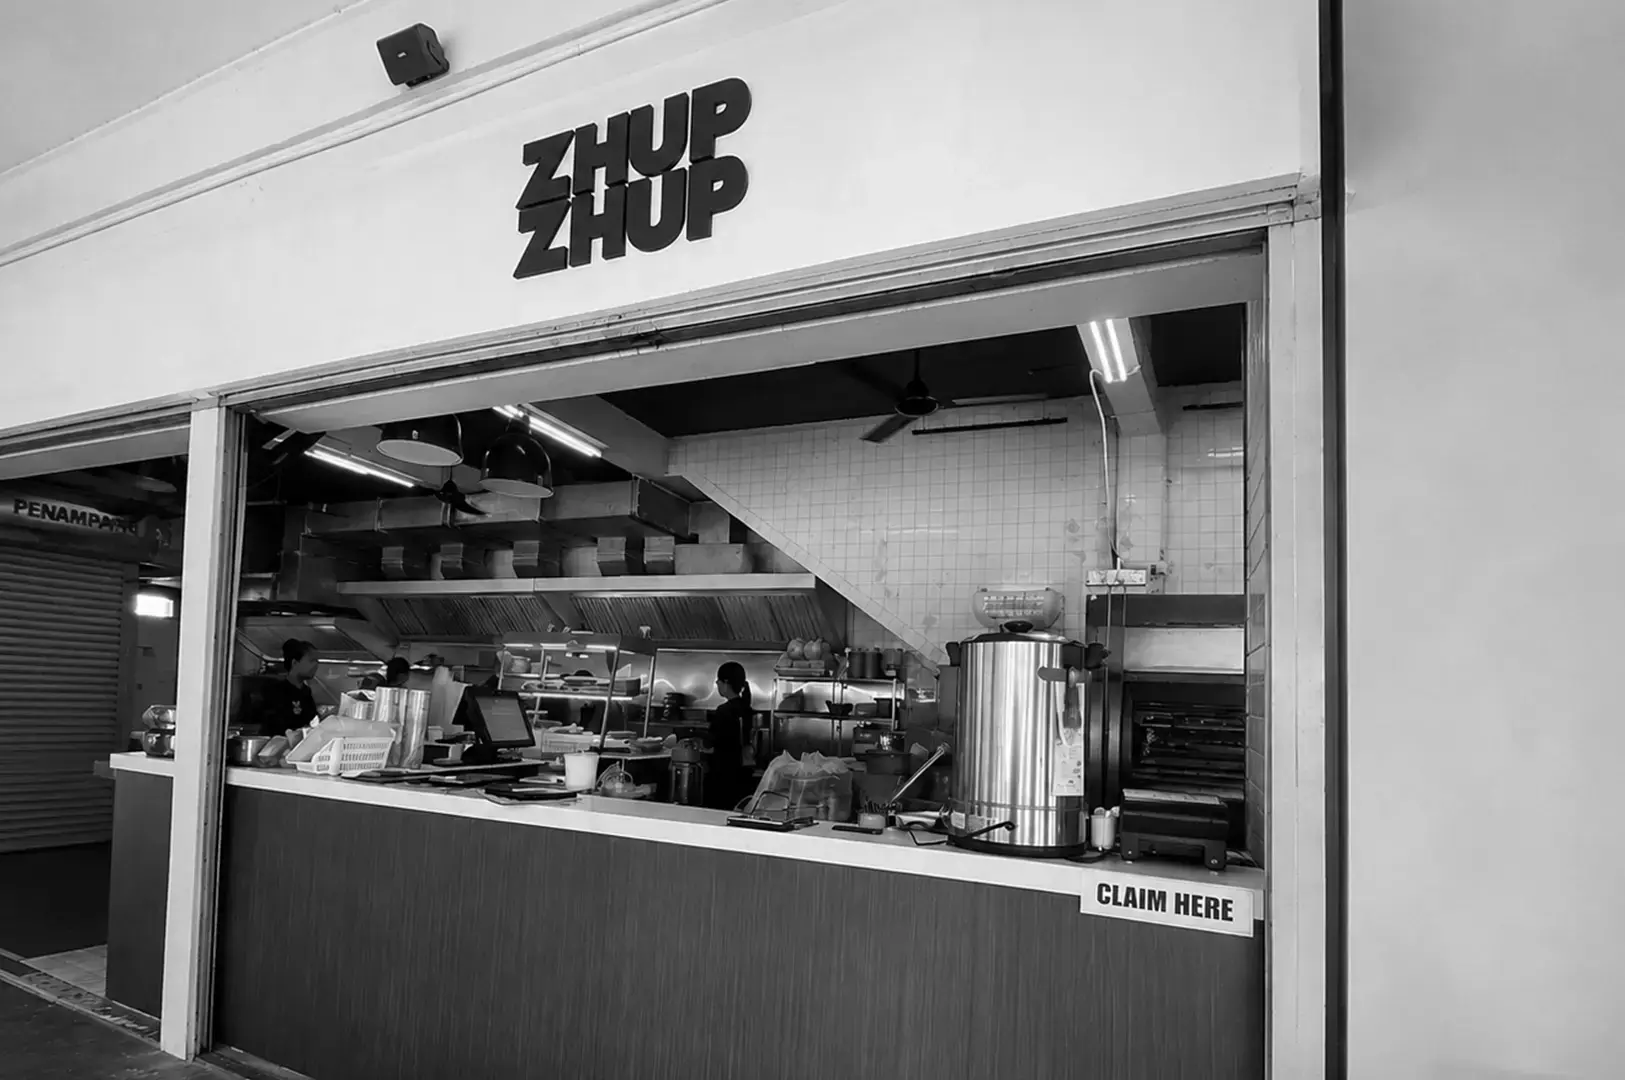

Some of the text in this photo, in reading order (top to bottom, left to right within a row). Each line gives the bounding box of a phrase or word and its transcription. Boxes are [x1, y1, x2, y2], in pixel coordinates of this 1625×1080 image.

[516, 77, 752, 209] ZHUP
[513, 155, 749, 279] ZHUP
[13, 499, 138, 533] PENAMPA
[1097, 883, 1234, 921] CLAIM HERE
